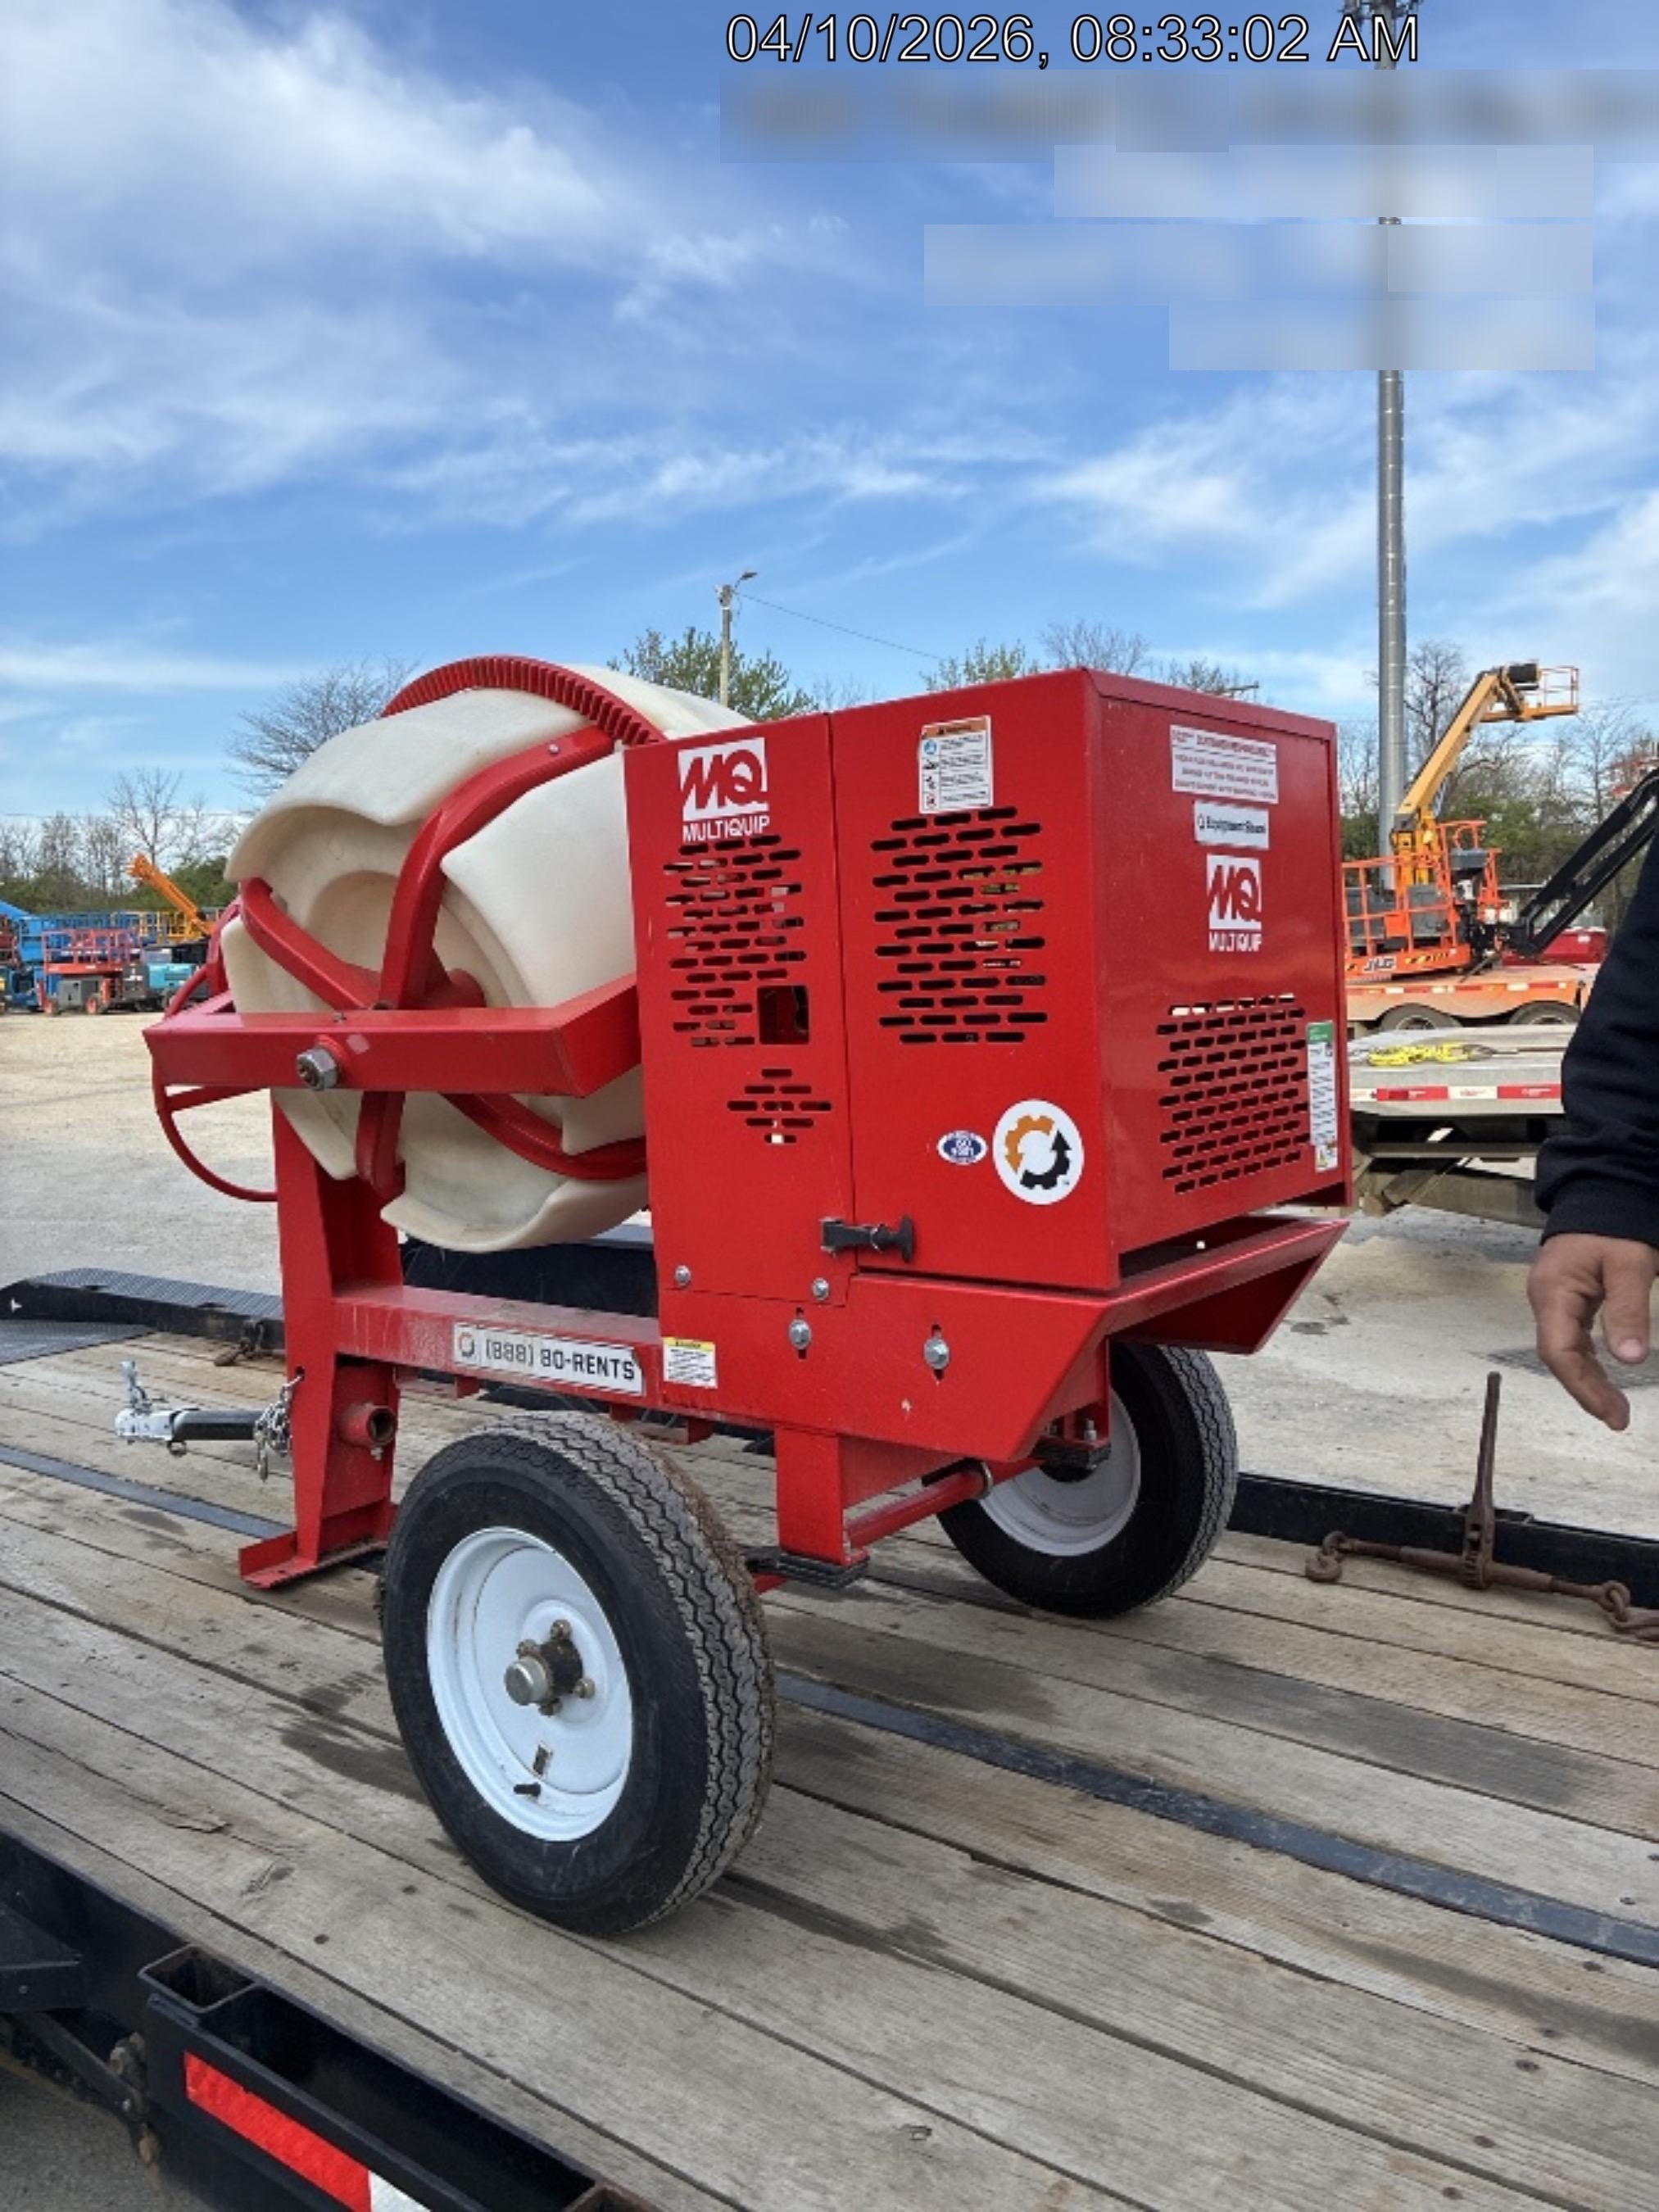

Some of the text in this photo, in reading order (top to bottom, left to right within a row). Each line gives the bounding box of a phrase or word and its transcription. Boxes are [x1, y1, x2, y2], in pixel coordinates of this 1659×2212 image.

[681, 750, 768, 809] MQ
[683, 816, 769, 843] MULTIQUIP
[1209, 865, 1262, 922] MQ
[1363, 956, 1396, 972] JLG
[486, 1338, 534, 1367] (888)
